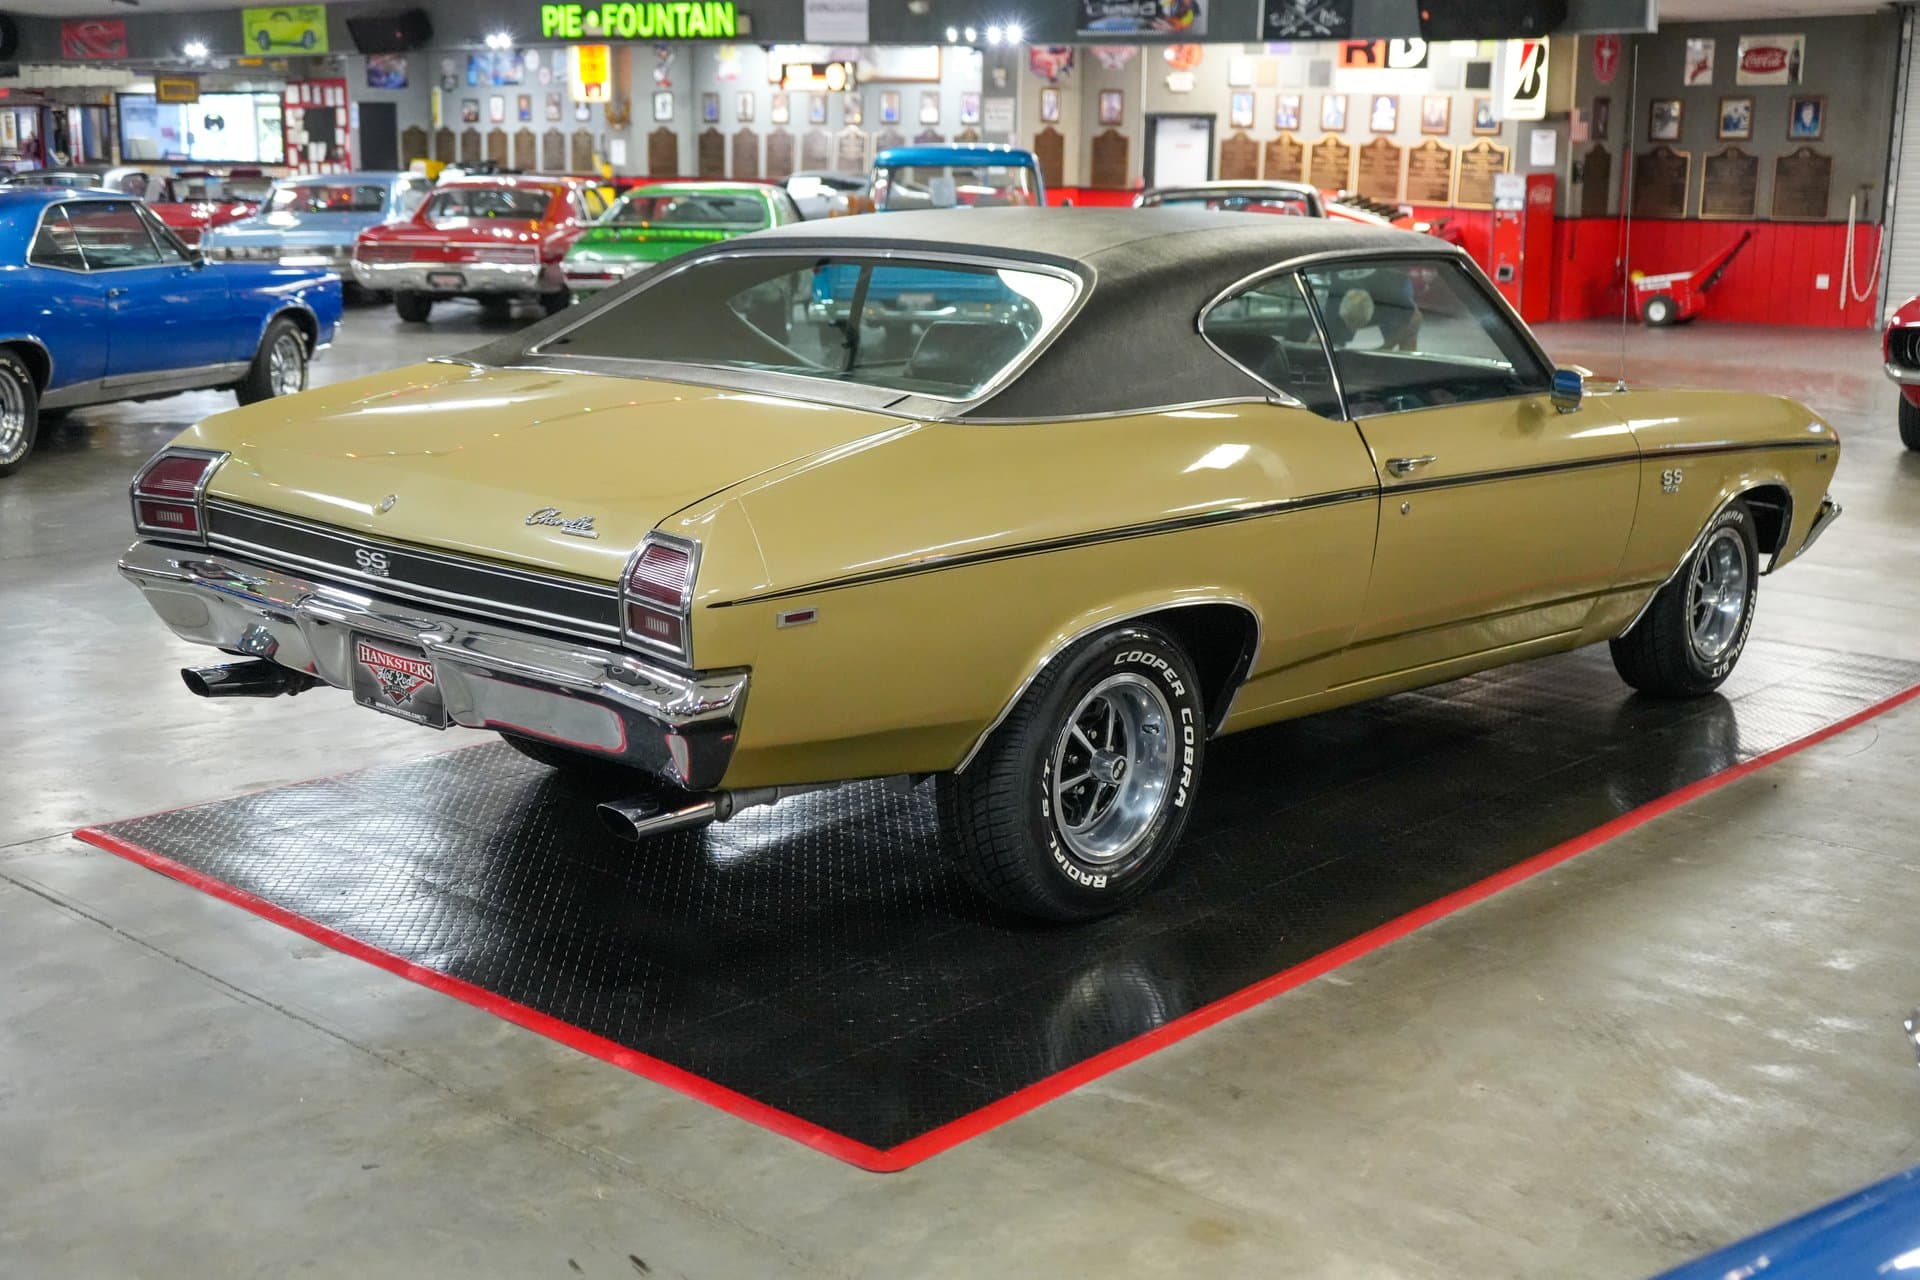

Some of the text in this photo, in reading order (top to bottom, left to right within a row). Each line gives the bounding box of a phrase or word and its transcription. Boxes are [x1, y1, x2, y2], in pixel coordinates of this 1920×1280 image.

[541, 2, 736, 38] PIE FOUNTAIN
[1663, 468, 1683, 486] SS
[1711, 510, 1744, 531] COBRA
[355, 548, 388, 570] SS
[360, 645, 434, 681] HANKSTERS
[377, 667, 393, 681] Hot
[1113, 651, 1195, 808] COOPER COBRA
[1041, 758, 1107, 889] RADIAL G/T
